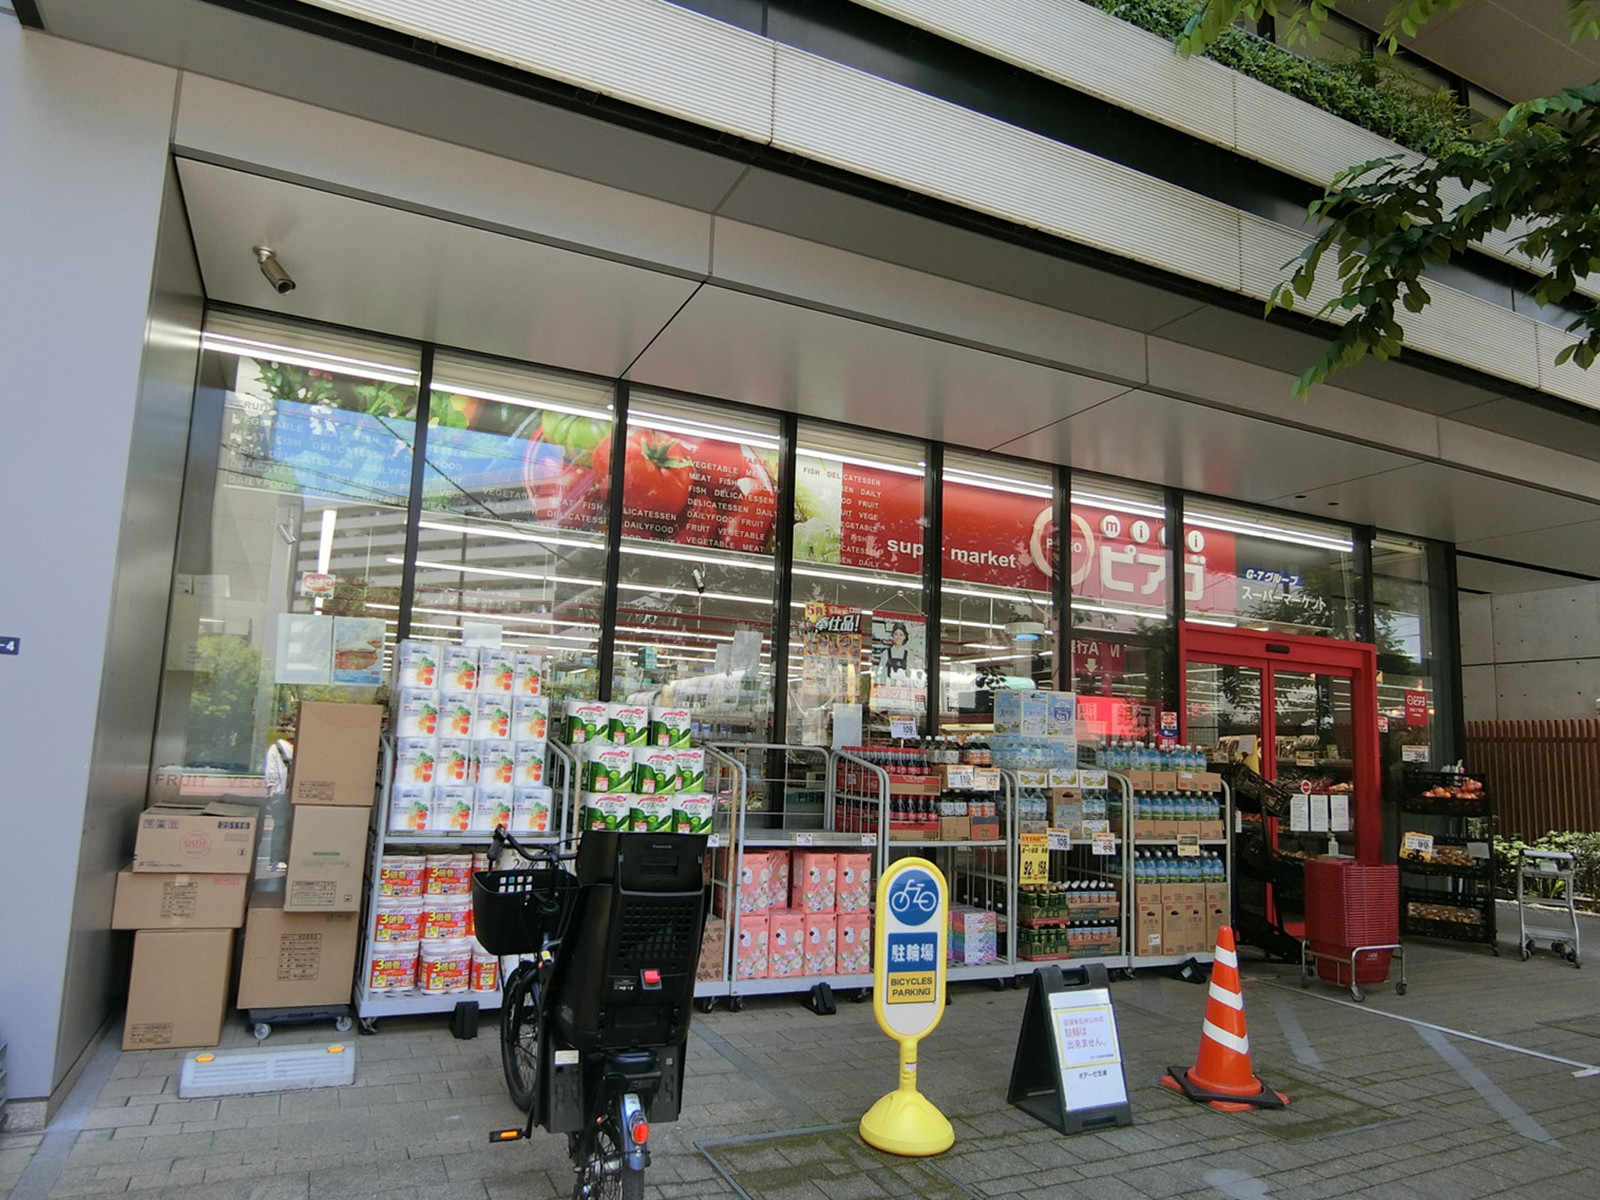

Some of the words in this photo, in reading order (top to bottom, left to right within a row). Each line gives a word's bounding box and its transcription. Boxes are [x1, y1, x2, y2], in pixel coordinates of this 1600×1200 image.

[690, 460, 739, 475] VEGETABLE
[803, 467, 821, 476] FISH
[688, 472, 712, 484] MEAT
[719, 477, 739, 488] FISH
[687, 484, 707, 496] FISH
[714, 489, 775, 505] DELICATESSEN
[687, 498, 749, 514] DELICATESSEN
[858, 499, 879, 509] FRUIT
[687, 510, 735, 524] DAILYFOOD
[741, 518, 765, 528] FRUIT
[624, 520, 674, 535] DAILYFOOD
[685, 522, 711, 534] FRUIT
[718, 527, 766, 541] VEGETABLE
[685, 535, 736, 550] VEGETABLE
[742, 543, 765, 553] MEAT
[951, 548, 1016, 569] market
[154, 774, 208, 787] FRUIT
[891, 943, 934, 963] 駐輪場
[890, 976, 933, 987] BICYCLES
[892, 987, 931, 997] PARKING
